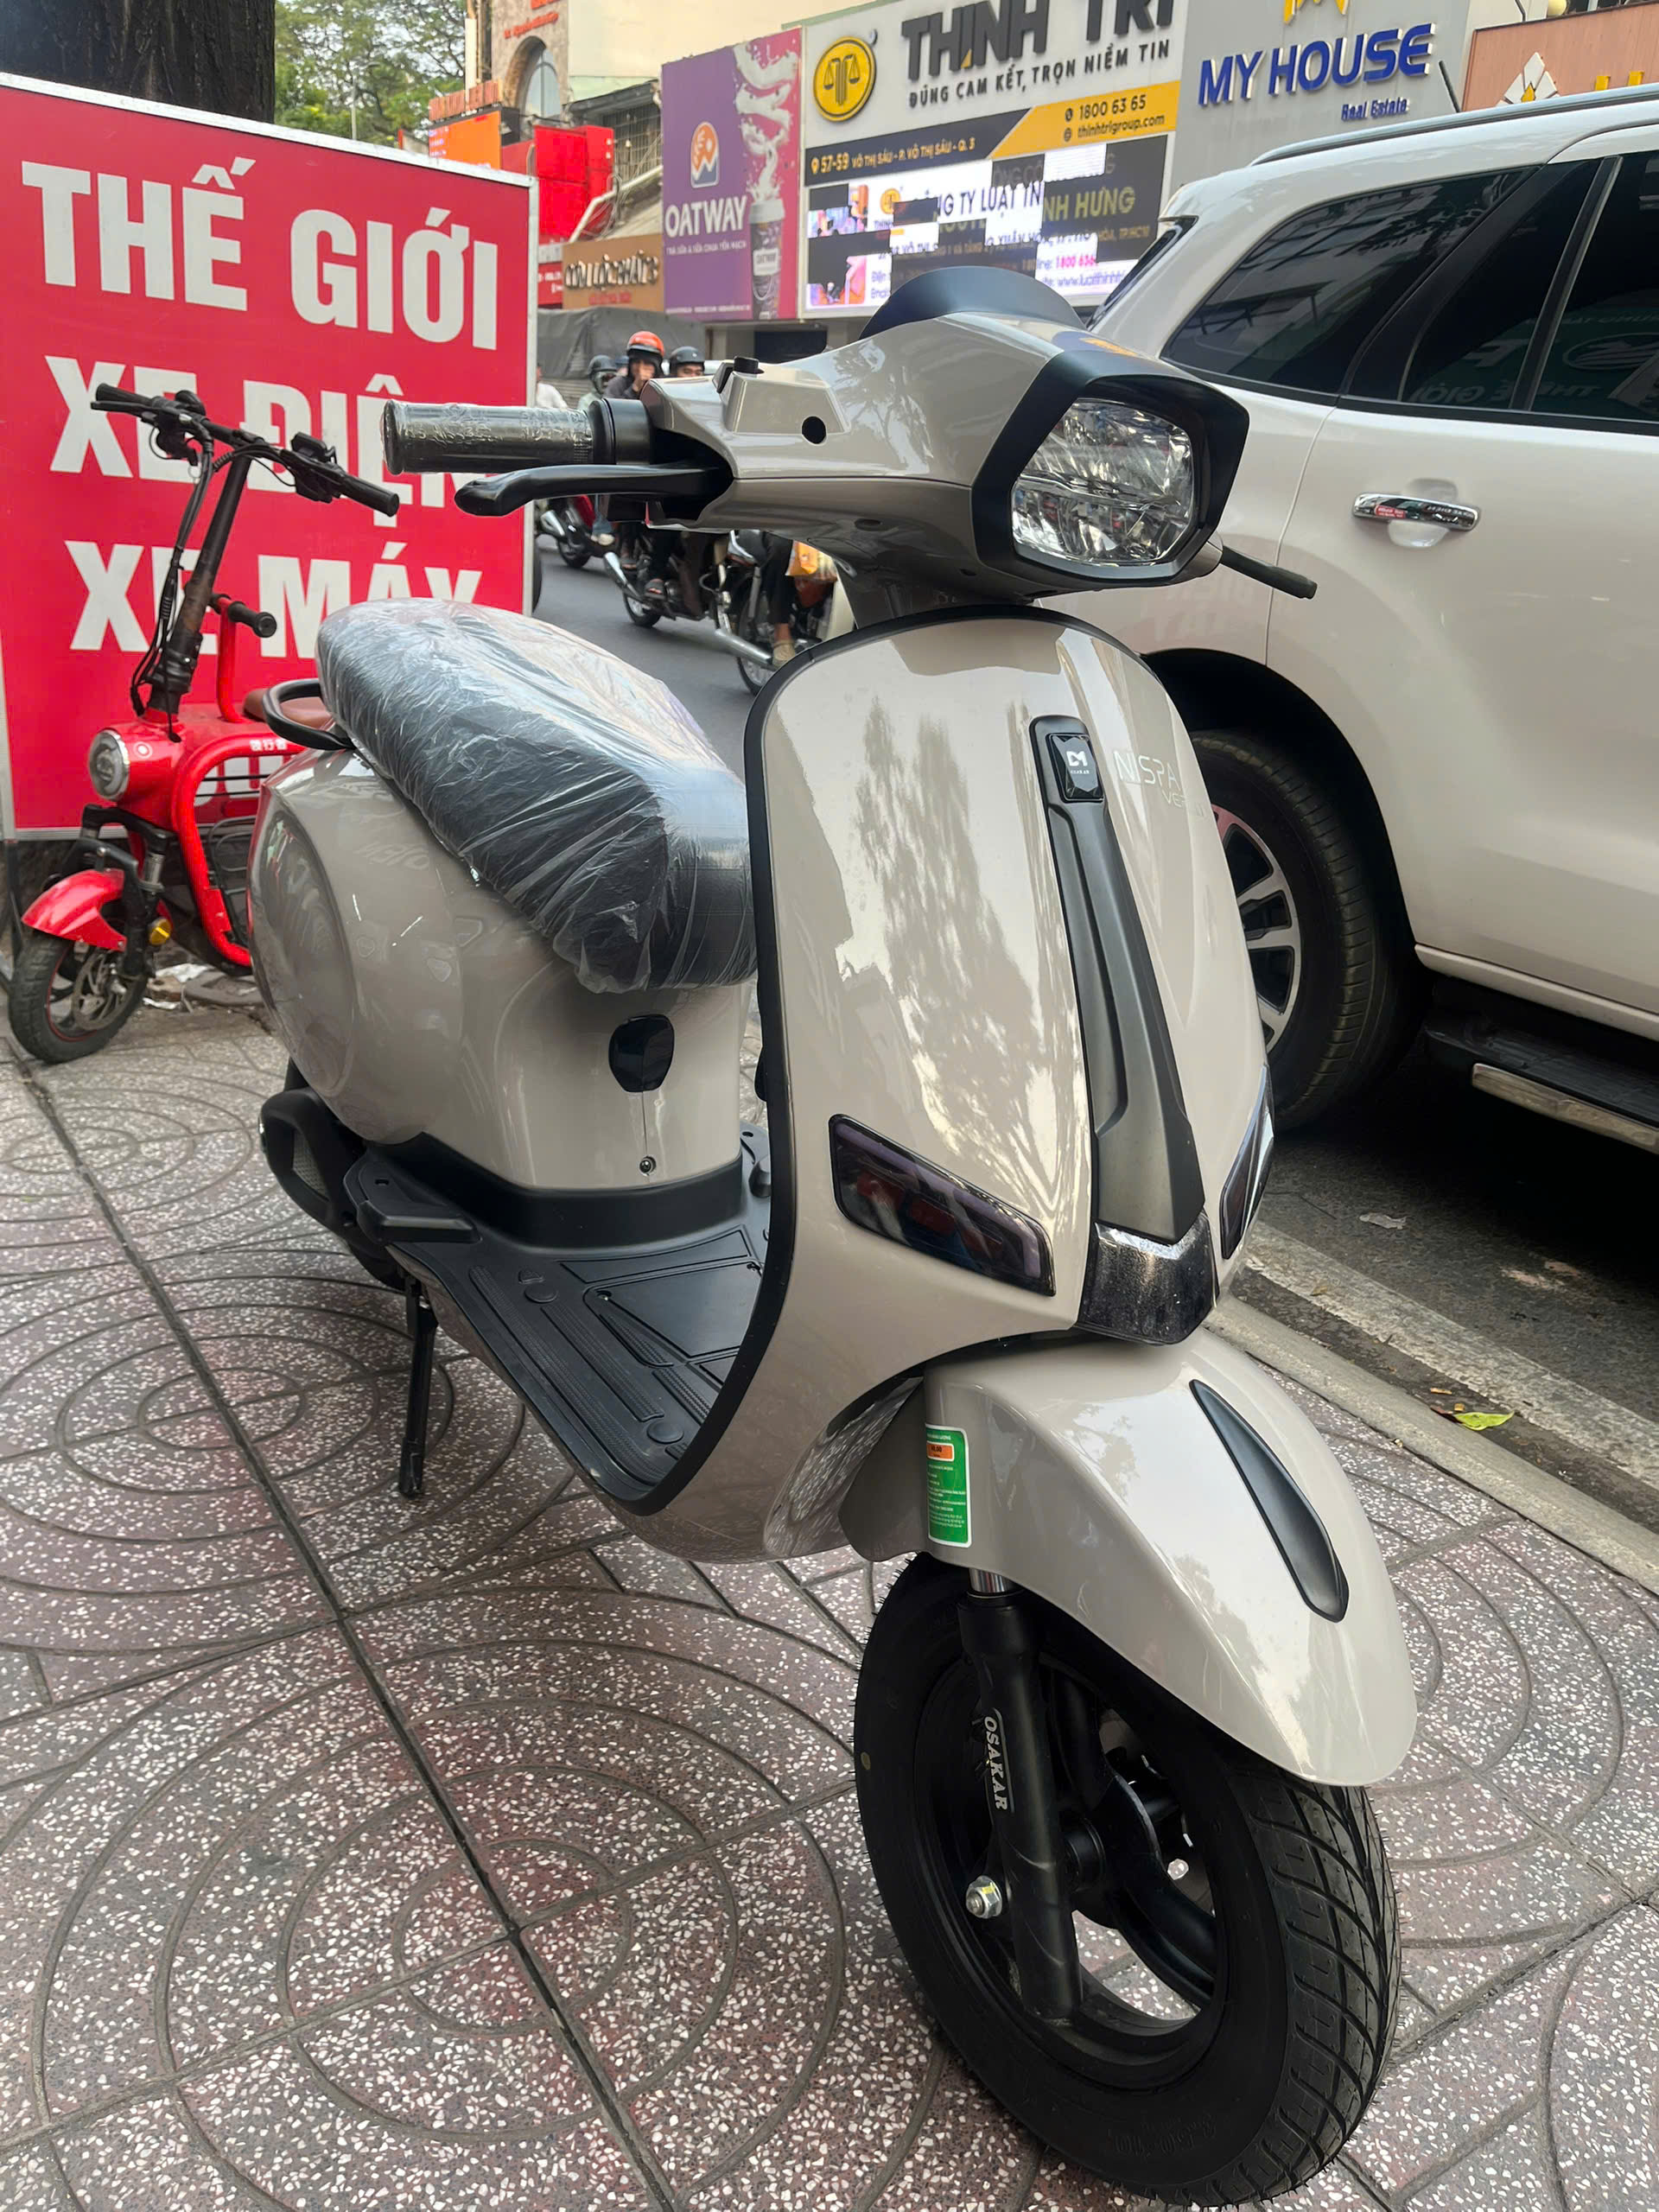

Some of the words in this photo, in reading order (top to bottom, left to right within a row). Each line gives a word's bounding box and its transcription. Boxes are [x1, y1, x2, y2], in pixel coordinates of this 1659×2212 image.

[910, 84, 949, 108] ĐÚNG
[956, 77, 988, 99] CAM
[1032, 59, 1076, 86] TRỌN
[1138, 39, 1170, 63] TIN
[1198, 49, 1267, 107] MY
[1268, 22, 1436, 97] HOUSE
[1077, 114, 1166, 138] thinhtrigroup.com
[1079, 100, 1109, 121] 1800
[1112, 98, 1128, 114] 63
[1131, 94, 1147, 111] 65
[1341, 101, 1368, 122] Real
[1370, 97, 1409, 118] Estate
[821, 151, 849, 174] 57-59
[664, 195, 747, 238] OATWAY
[22, 157, 256, 310] THẾ
[290, 207, 499, 350] GIỚI
[45, 355, 199, 483] XE
[239, 372, 491, 527] ĐIỆ
[984, 1716, 1007, 1810] OSAKAR
